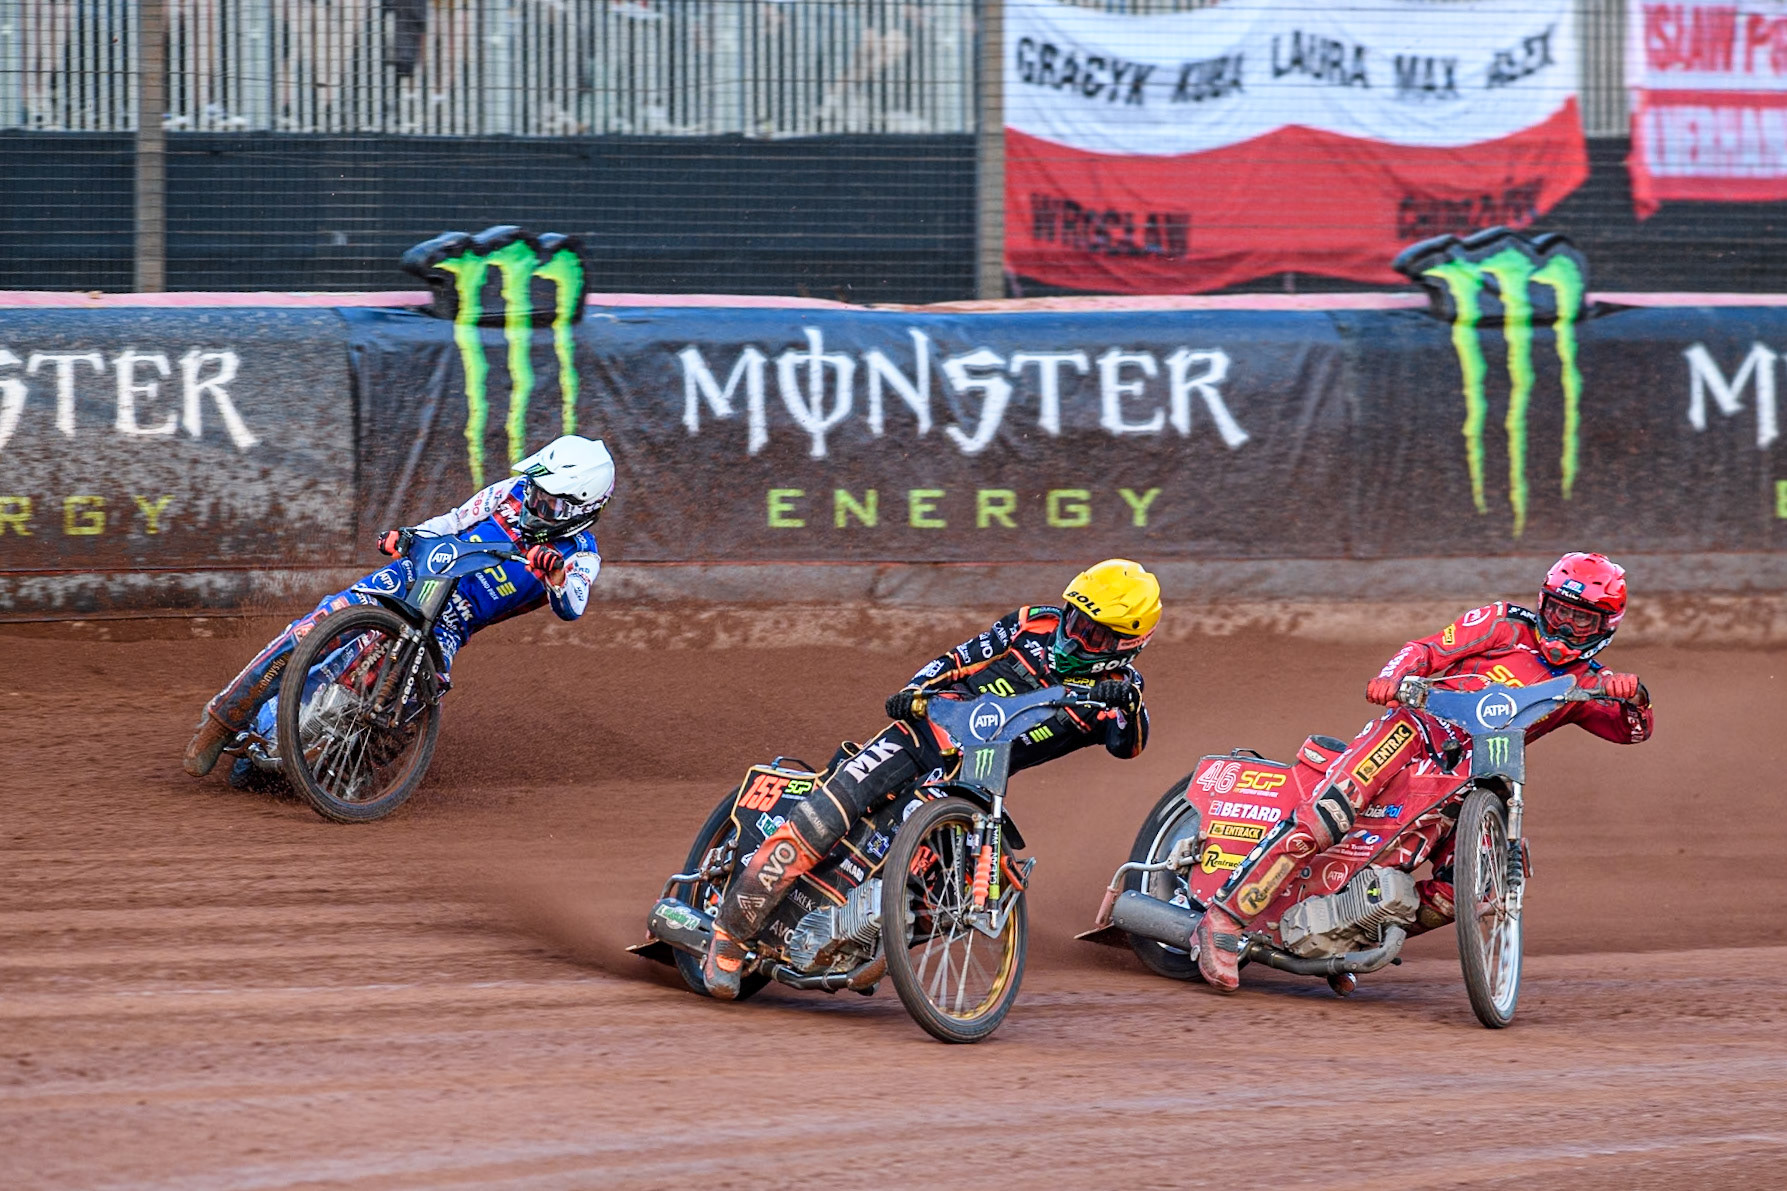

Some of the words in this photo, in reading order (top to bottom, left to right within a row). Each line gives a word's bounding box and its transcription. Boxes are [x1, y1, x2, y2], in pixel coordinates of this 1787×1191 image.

[1272, 30, 1369, 88] LAURA
[1395, 54, 1460, 98] MAX
[678, 326, 1250, 460] MONSTER
[767, 488, 1162, 529] ENERGY
[432, 552, 453, 564] ATPI
[1067, 591, 1102, 617] BOLL
[1090, 654, 1136, 675] BOLL
[973, 713, 999, 729] ATPI
[1483, 704, 1510, 718] ATPI
[843, 737, 903, 784] MK
[1197, 760, 1241, 795] 46
[1236, 770, 1287, 791] SGP
[738, 774, 789, 812] 155
[784, 780, 812, 796] SGP
[1221, 802, 1282, 823] BETARD
[1224, 825, 1261, 840] ENTRACK
[756, 841, 798, 891] AVO
